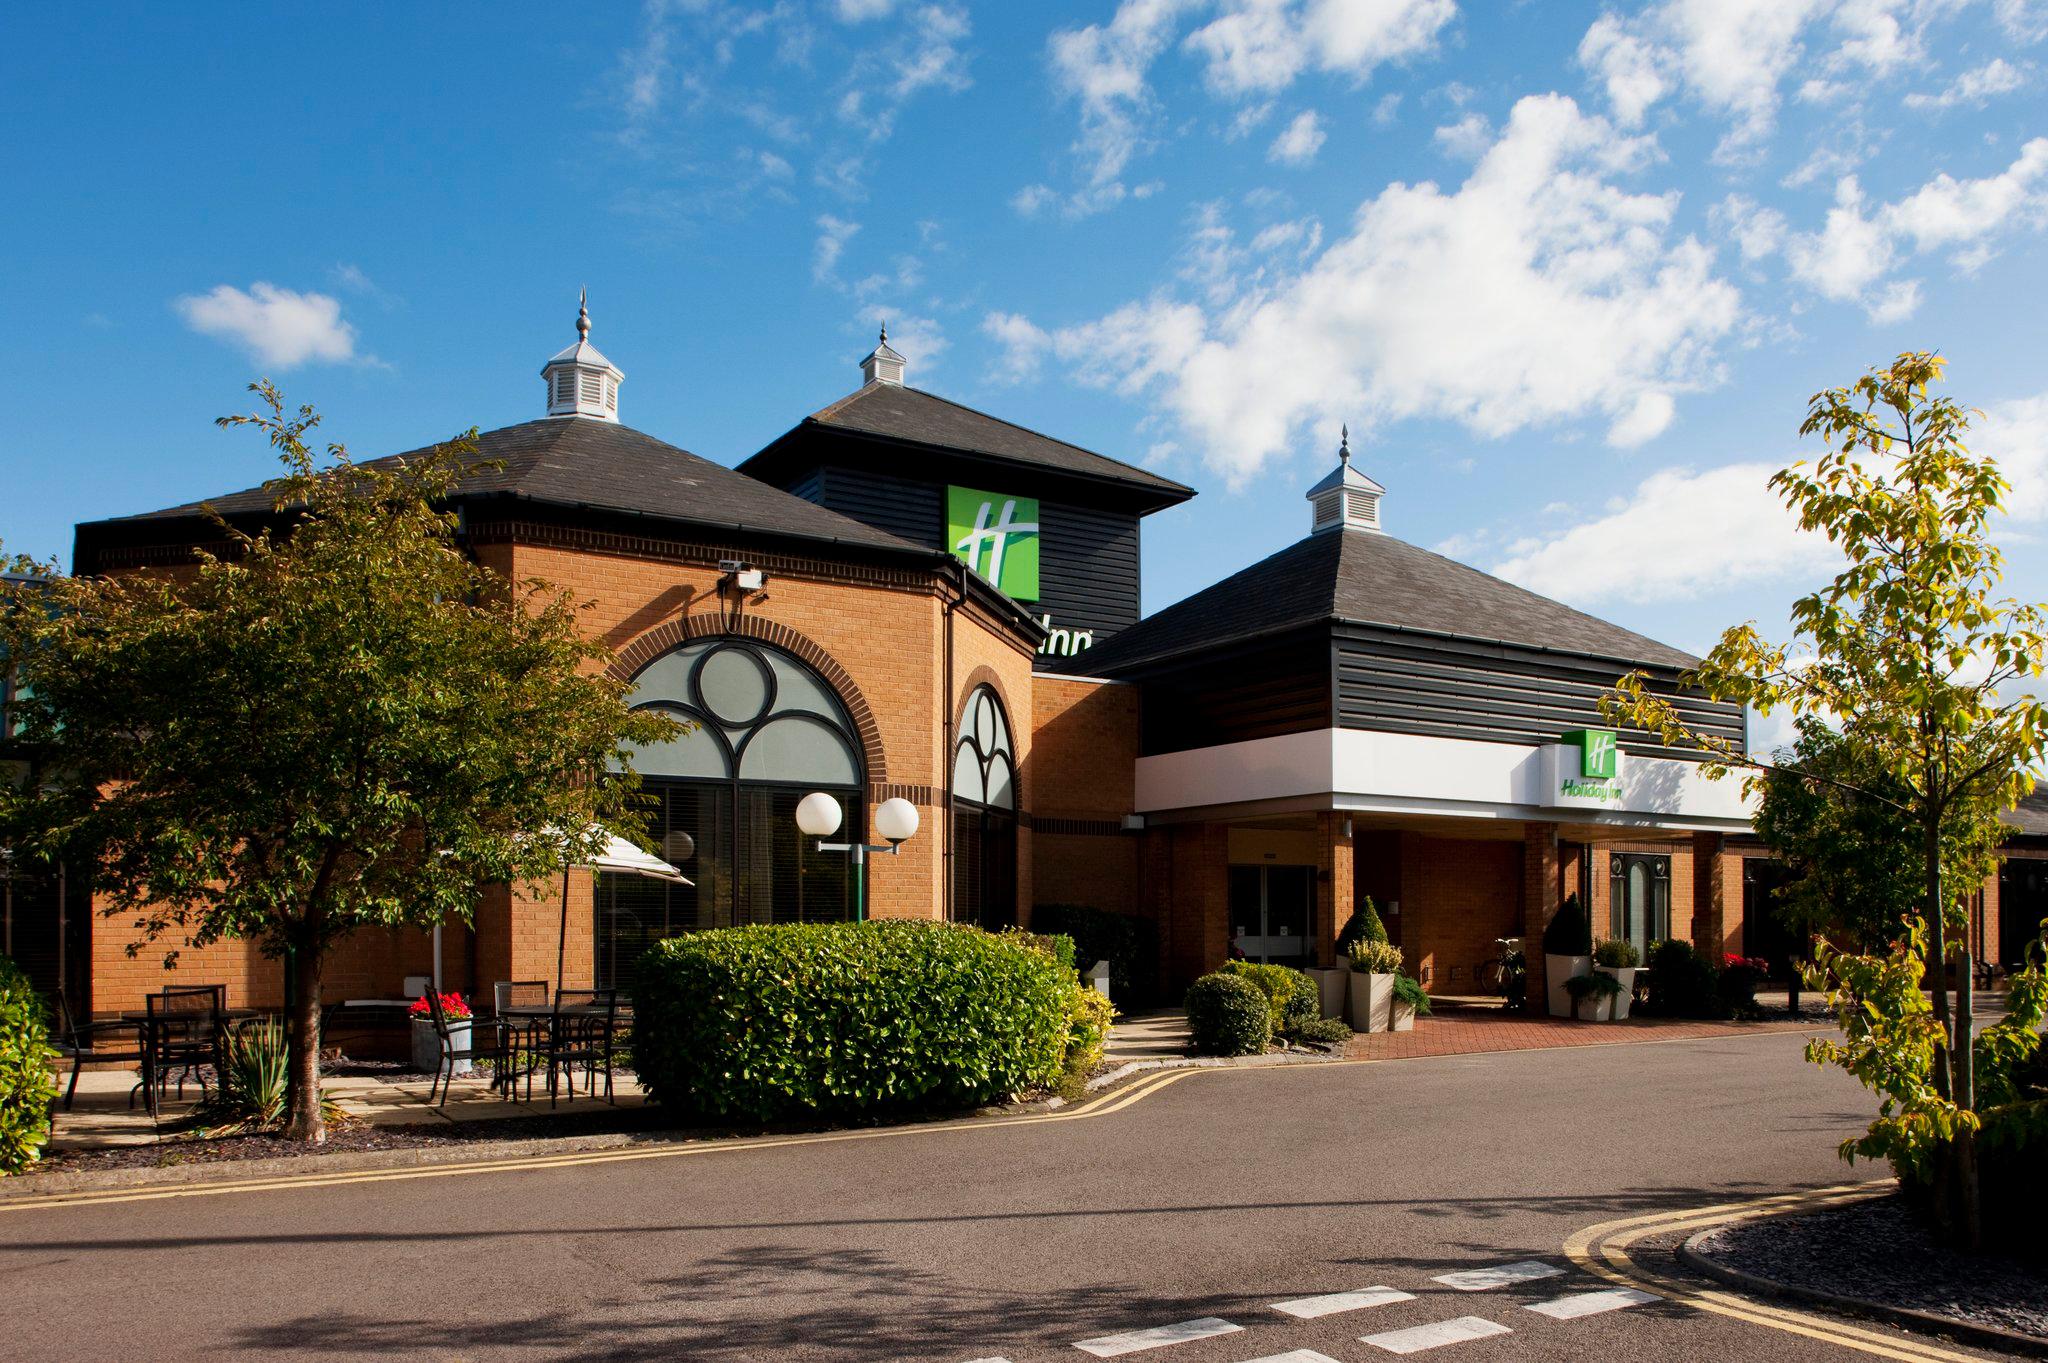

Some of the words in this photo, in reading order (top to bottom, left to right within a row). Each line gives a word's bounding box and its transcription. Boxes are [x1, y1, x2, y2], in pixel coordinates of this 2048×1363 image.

[1589, 735, 1615, 774] H
[1561, 779, 1607, 802] Holiday
[1609, 782, 1622, 799] Inn
